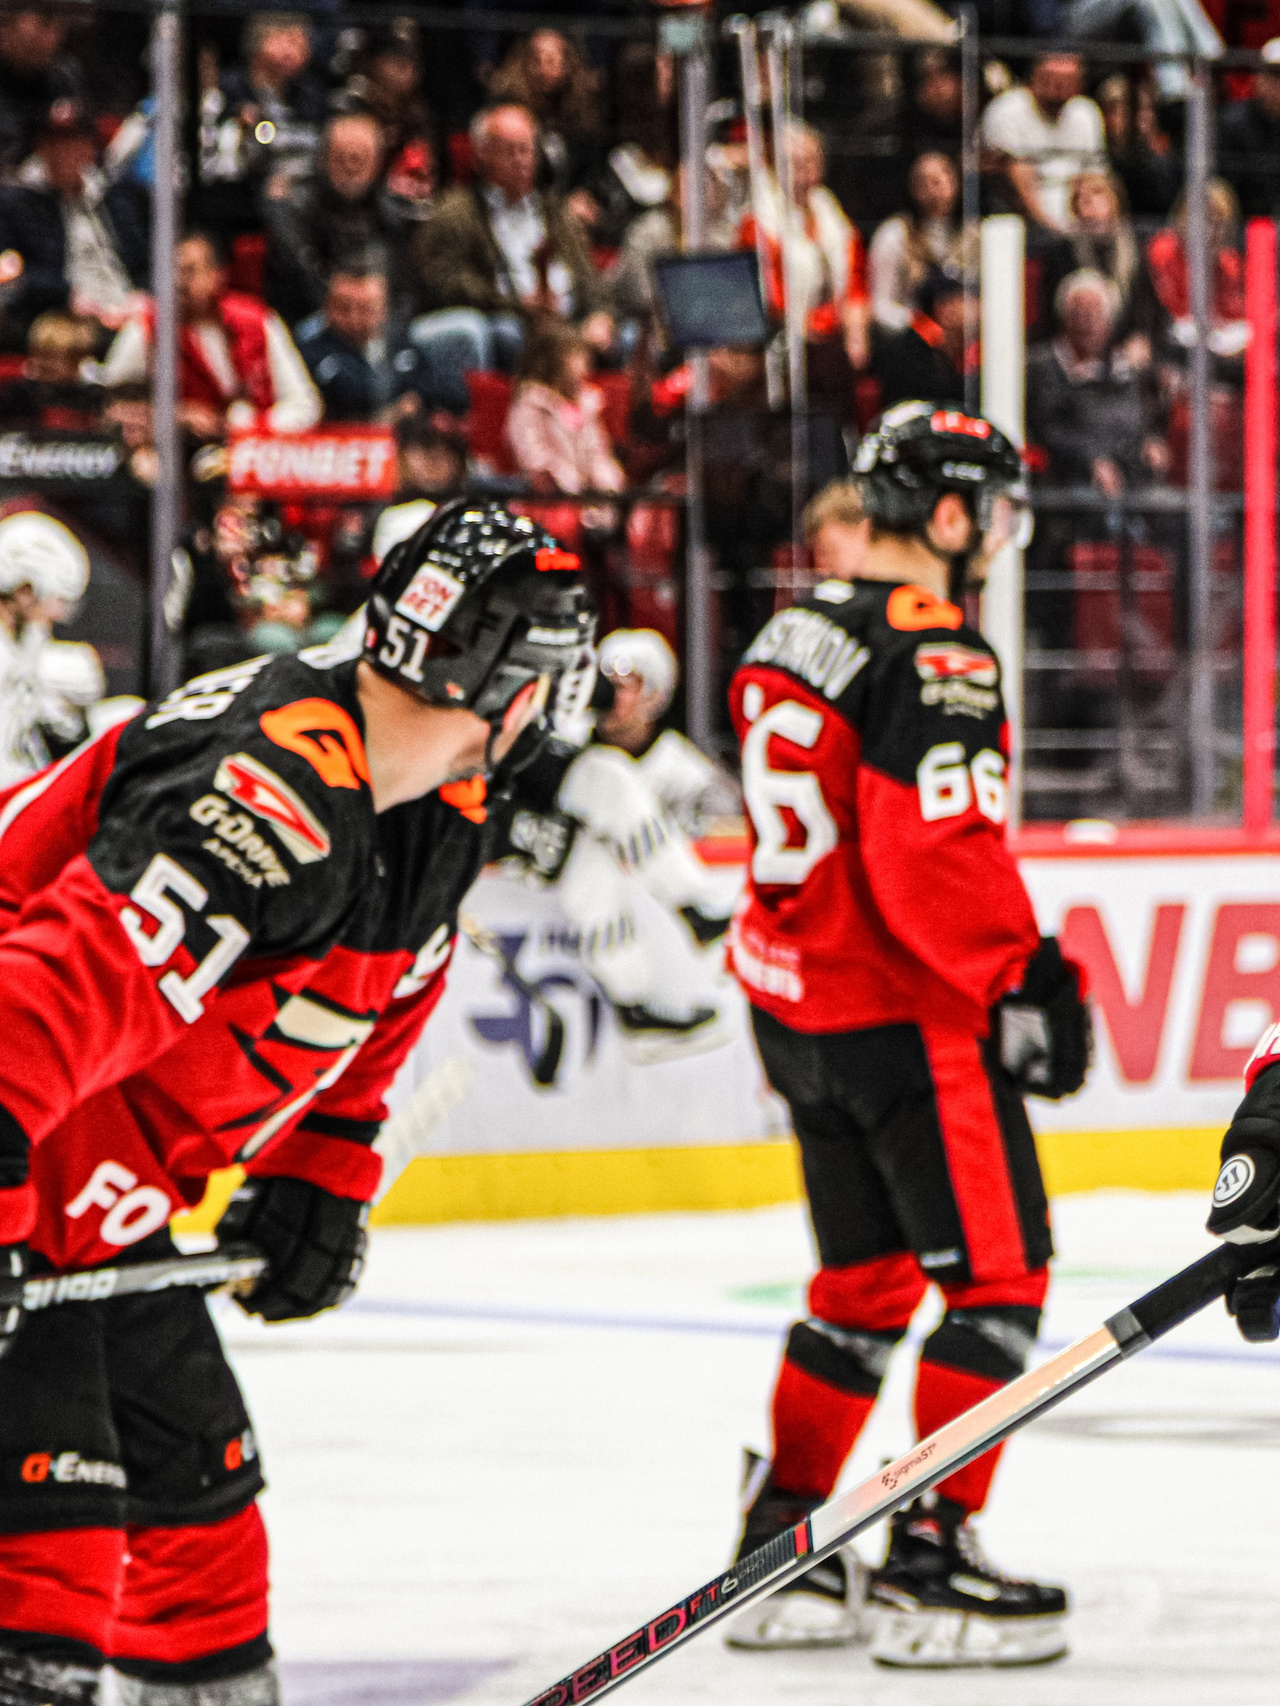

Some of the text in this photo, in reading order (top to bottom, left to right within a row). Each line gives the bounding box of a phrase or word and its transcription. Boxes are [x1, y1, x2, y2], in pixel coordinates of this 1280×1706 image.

[378, 615, 429, 682] 51
[742, 683, 838, 885] 6
[917, 741, 1006, 823] 66
[119, 853, 250, 1024] 51
